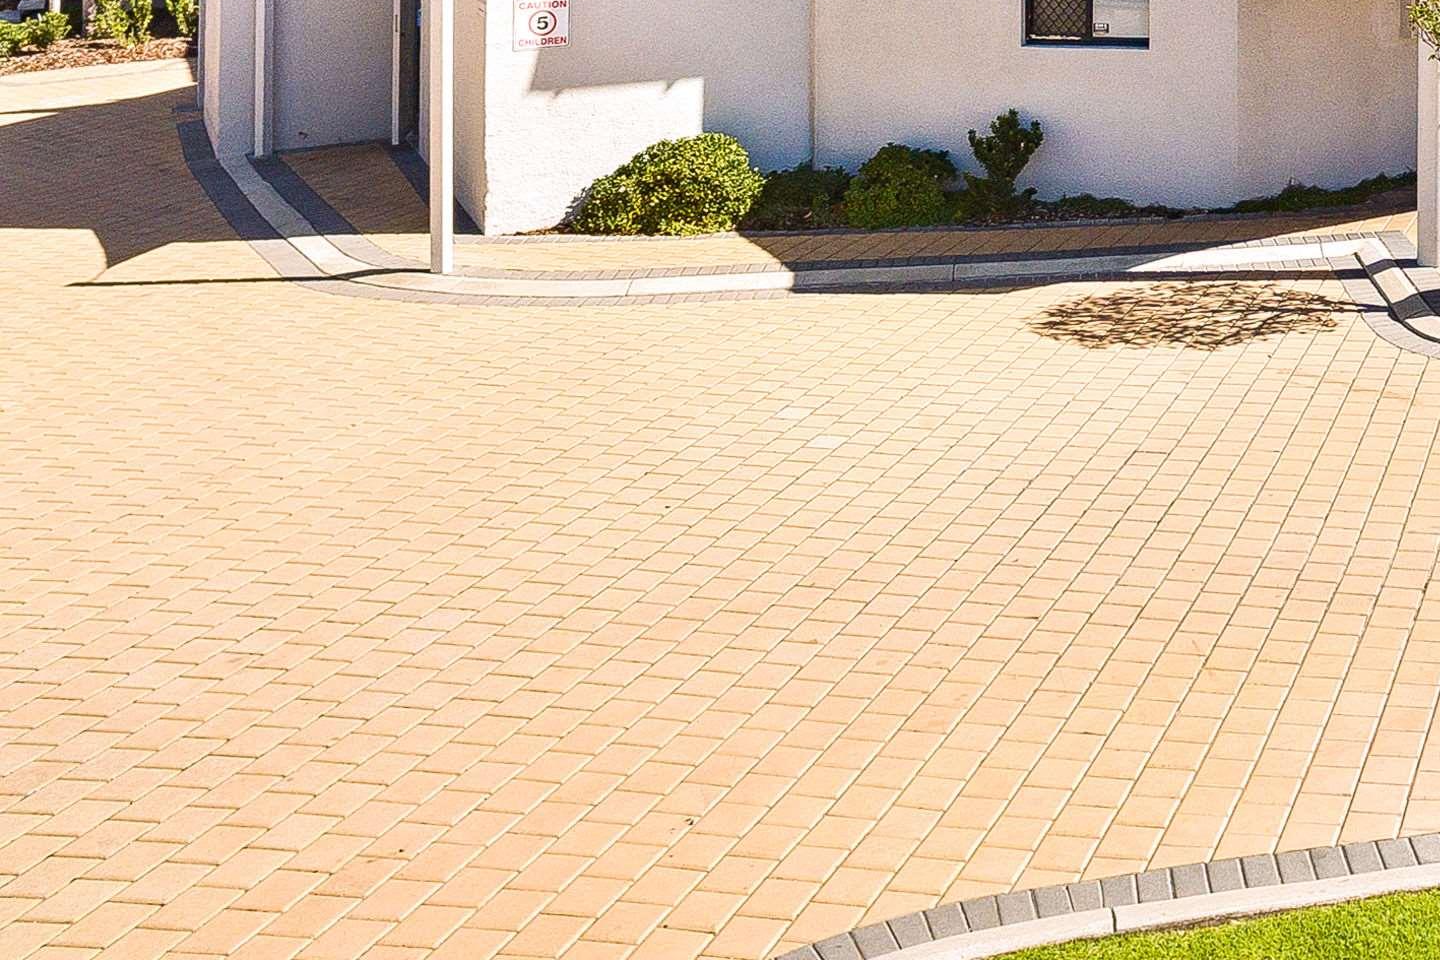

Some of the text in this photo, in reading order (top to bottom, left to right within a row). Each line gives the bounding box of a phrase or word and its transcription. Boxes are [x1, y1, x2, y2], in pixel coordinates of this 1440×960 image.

[518, 0, 567, 10] CAUTION
[536, 16, 549, 30] 5
[518, 36, 567, 46] CHILDREN
